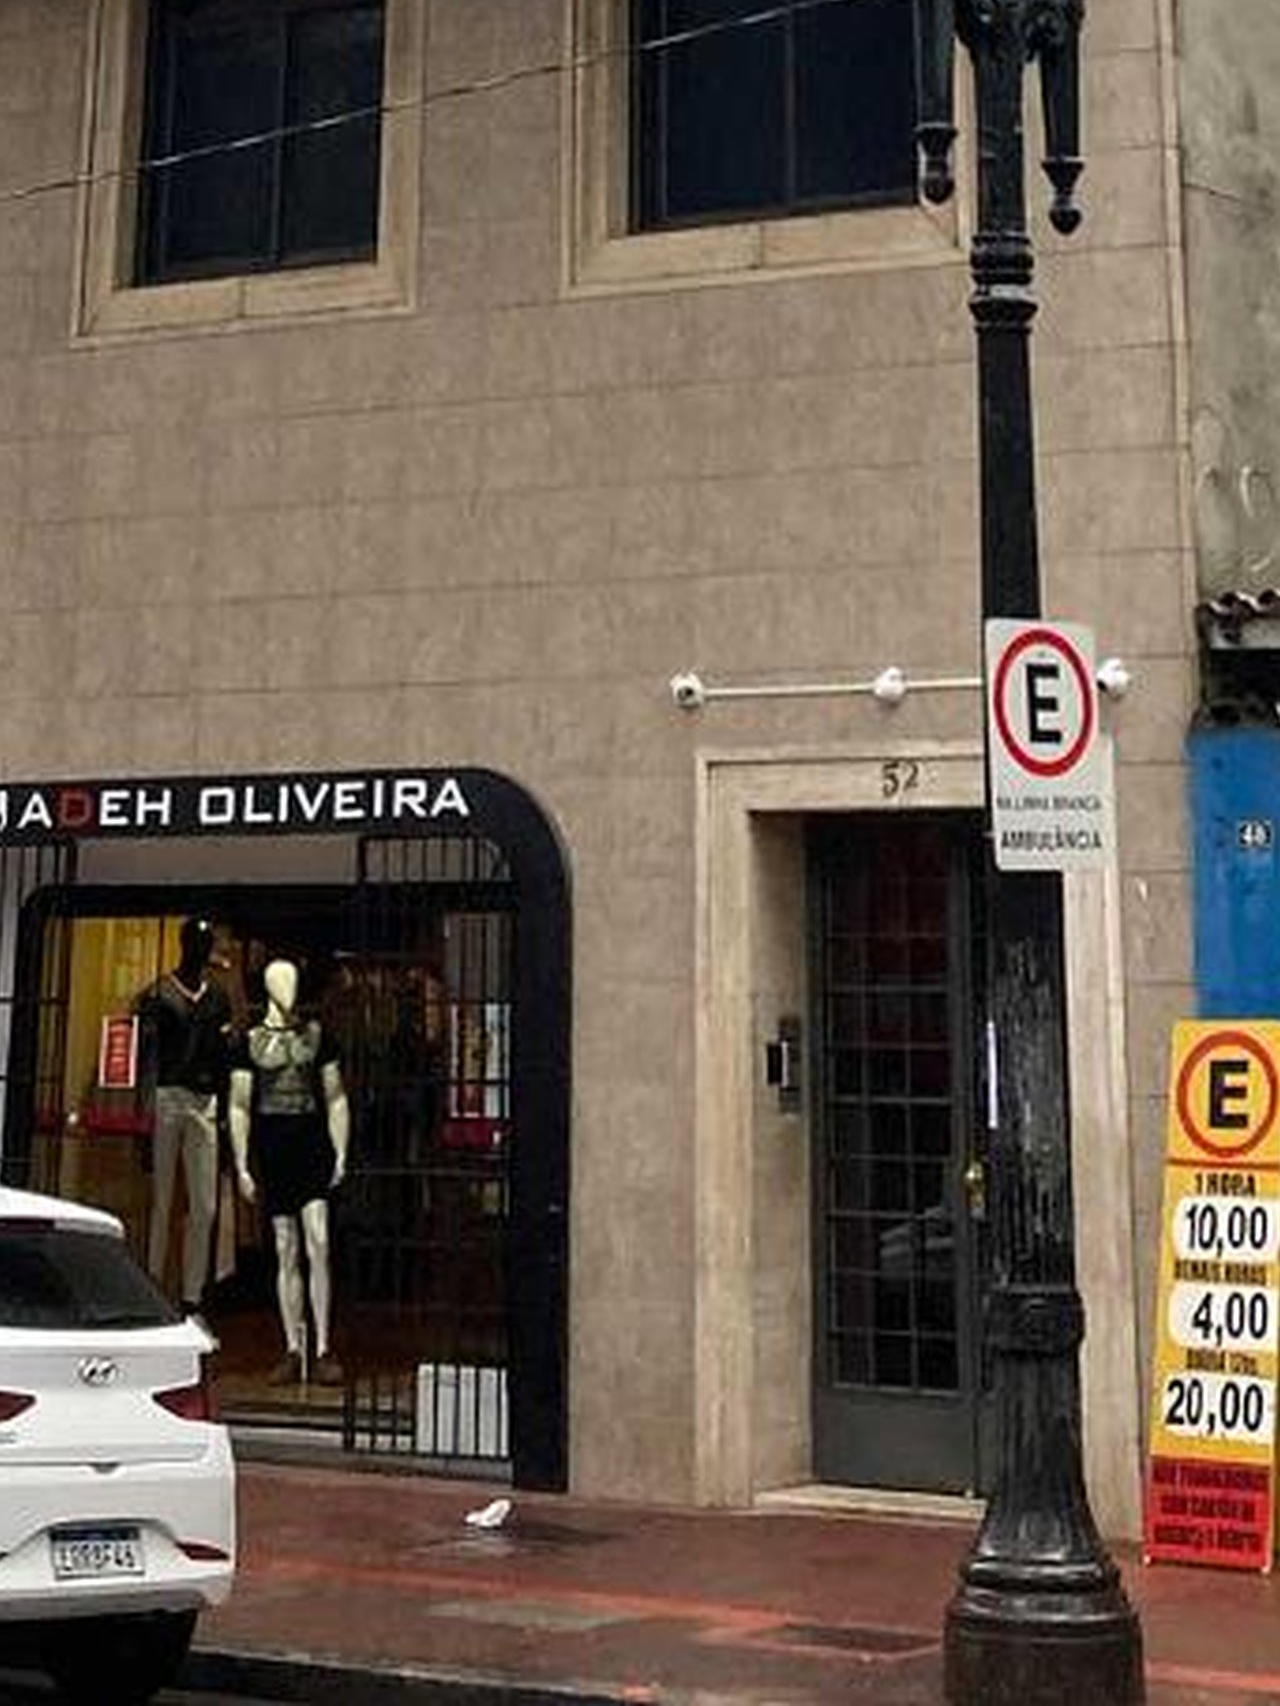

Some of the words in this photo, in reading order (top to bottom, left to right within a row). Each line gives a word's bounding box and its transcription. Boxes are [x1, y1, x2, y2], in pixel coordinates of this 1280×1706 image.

[1026, 663, 1062, 744] E
[19, 789, 173, 829] ADEH
[199, 778, 471, 825] OLIVEIRA
[882, 759, 919, 799] 52
[1001, 825, 1102, 850] AMBULÂNCIA
[1208, 1060, 1249, 1129] E
[1186, 1204, 1268, 1257] 10,00
[1192, 1291, 1268, 1347] 4,00
[1164, 1378, 1264, 1435] 20,00
